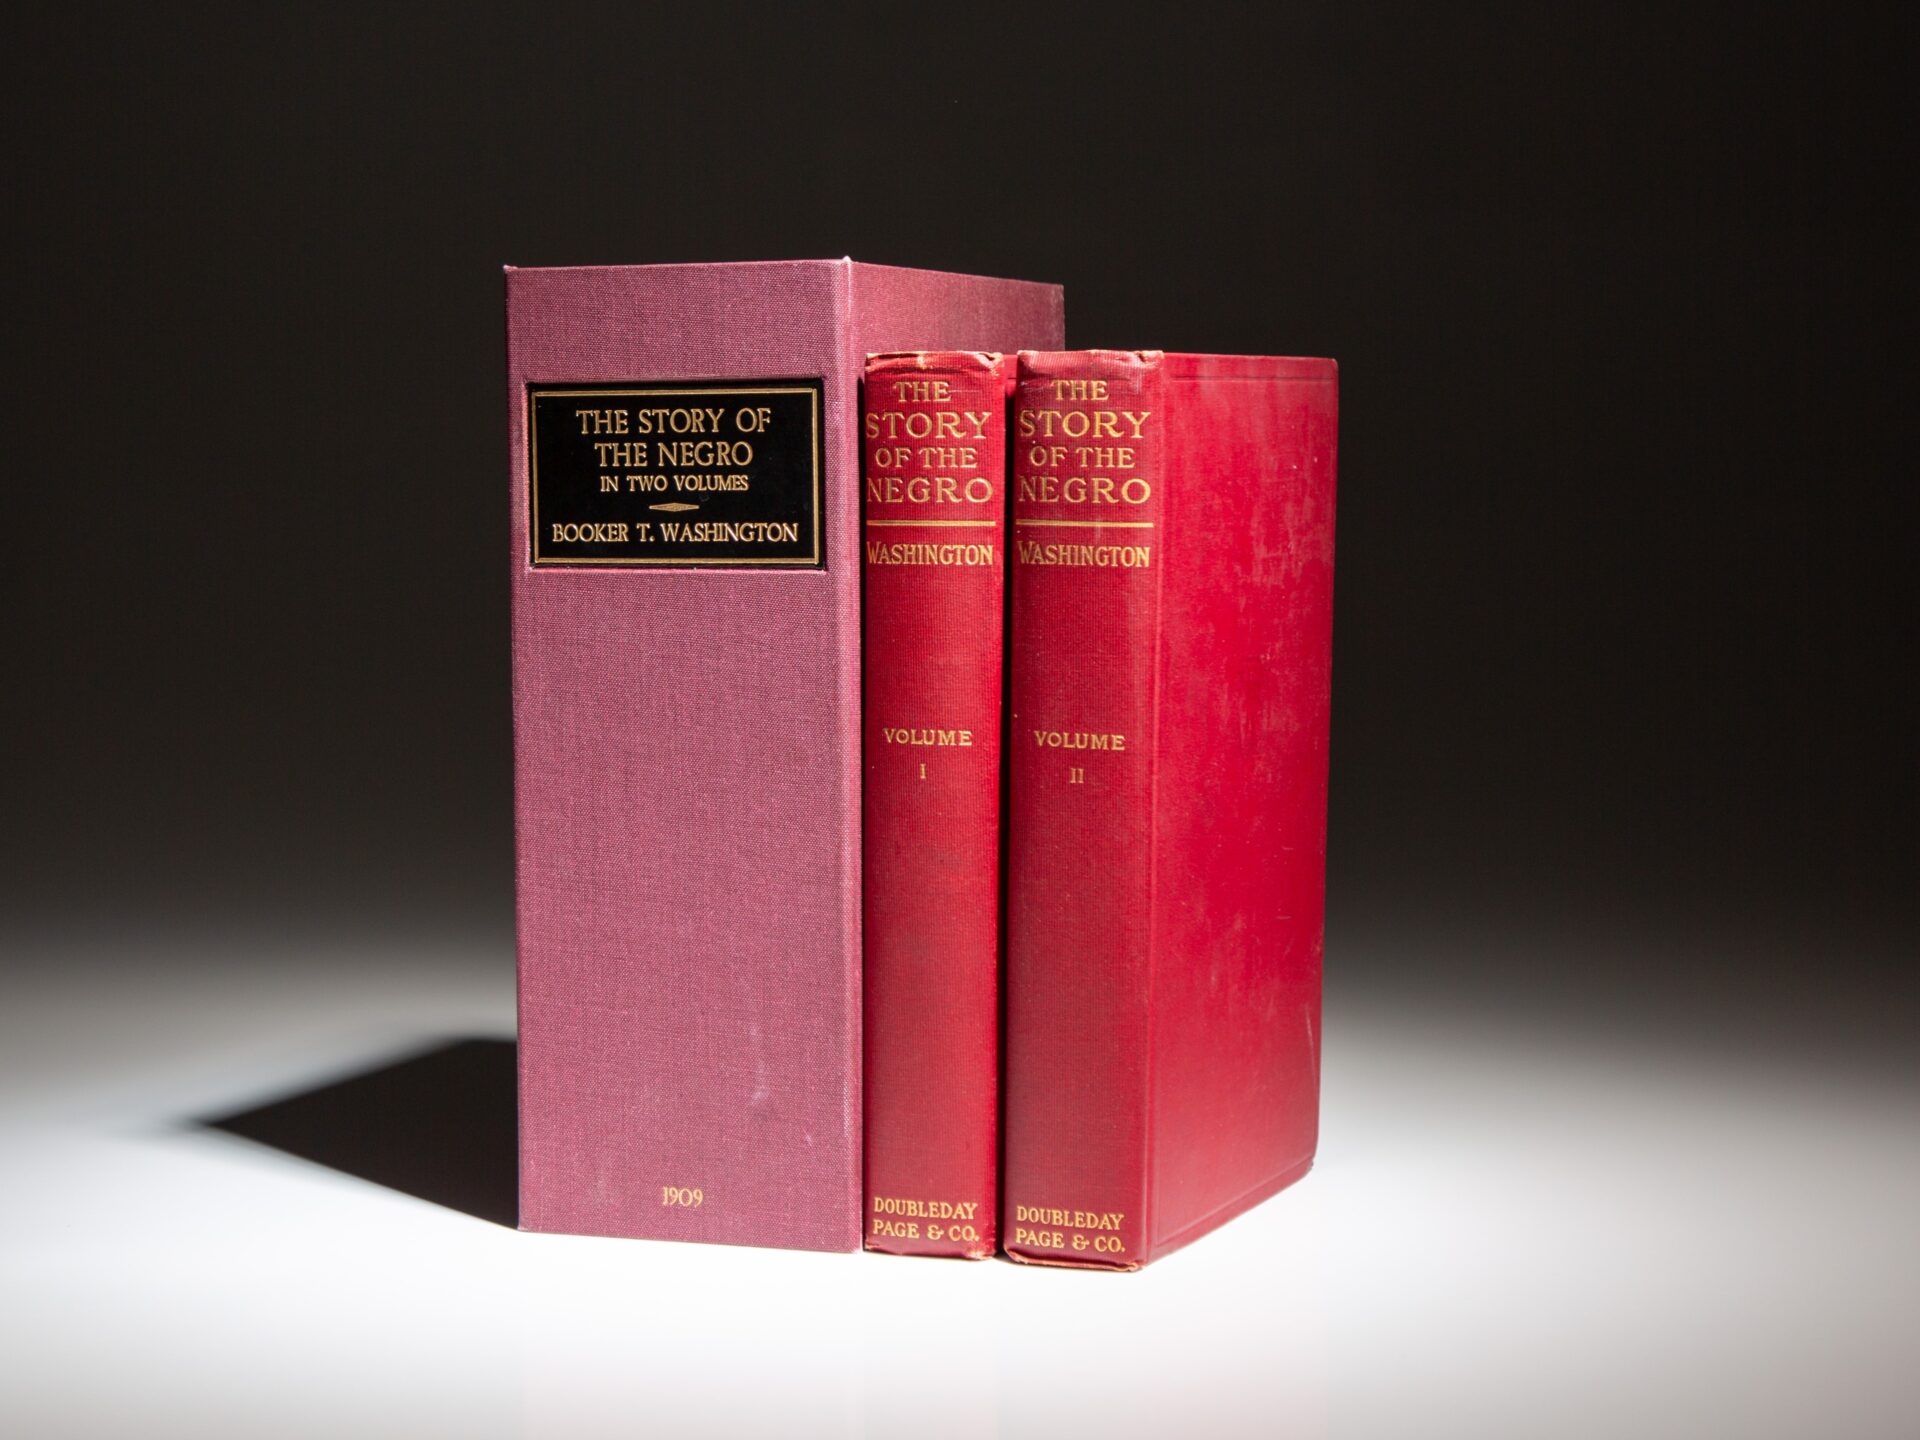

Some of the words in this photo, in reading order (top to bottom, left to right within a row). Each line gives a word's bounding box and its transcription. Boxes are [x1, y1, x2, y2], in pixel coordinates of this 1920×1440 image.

[896, 381, 952, 403] THE
[1051, 380, 1109, 401] THE
[576, 409, 628, 435] THE
[639, 408, 725, 434] STORY
[736, 407, 771, 433] OF
[866, 411, 992, 439] STORY
[1019, 410, 1151, 438] STORY
[595, 442, 647, 467] THE
[658, 441, 753, 467] NEGRO
[875, 448, 912, 468] OF
[918, 447, 978, 468] THE
[1030, 447, 1067, 466] OF
[1073, 447, 1135, 468] THE
[600, 476, 618, 492] IN
[627, 475, 668, 492] TWO
[676, 475, 749, 492] VOLUMES
[867, 477, 993, 503] NEGRO
[1018, 476, 1151, 504] NEGRO
[552, 523, 629, 543] BOOKER
[637, 523, 655, 543] T.
[661, 522, 799, 543] WASHINGTON
[866, 541, 993, 565] WASHINGTON
[1017, 540, 1150, 568] WASHINGTON
[883, 728, 973, 746] VOLUME
[1034, 730, 1126, 751] VOLUME
[919, 763, 927, 779] I
[1069, 768, 1084, 784] II
[662, 1186, 704, 1208] 1909
[874, 1197, 978, 1220] DOUBLEDAY
[1017, 1205, 1125, 1231] DOUBLEDAY
[873, 1219, 920, 1239] PAGE
[927, 1222, 945, 1240] &
[949, 1225, 980, 1242] CO.
[1015, 1228, 1065, 1249] PAGE
[1072, 1235, 1090, 1251] &
[1094, 1236, 1126, 1253] CO.
